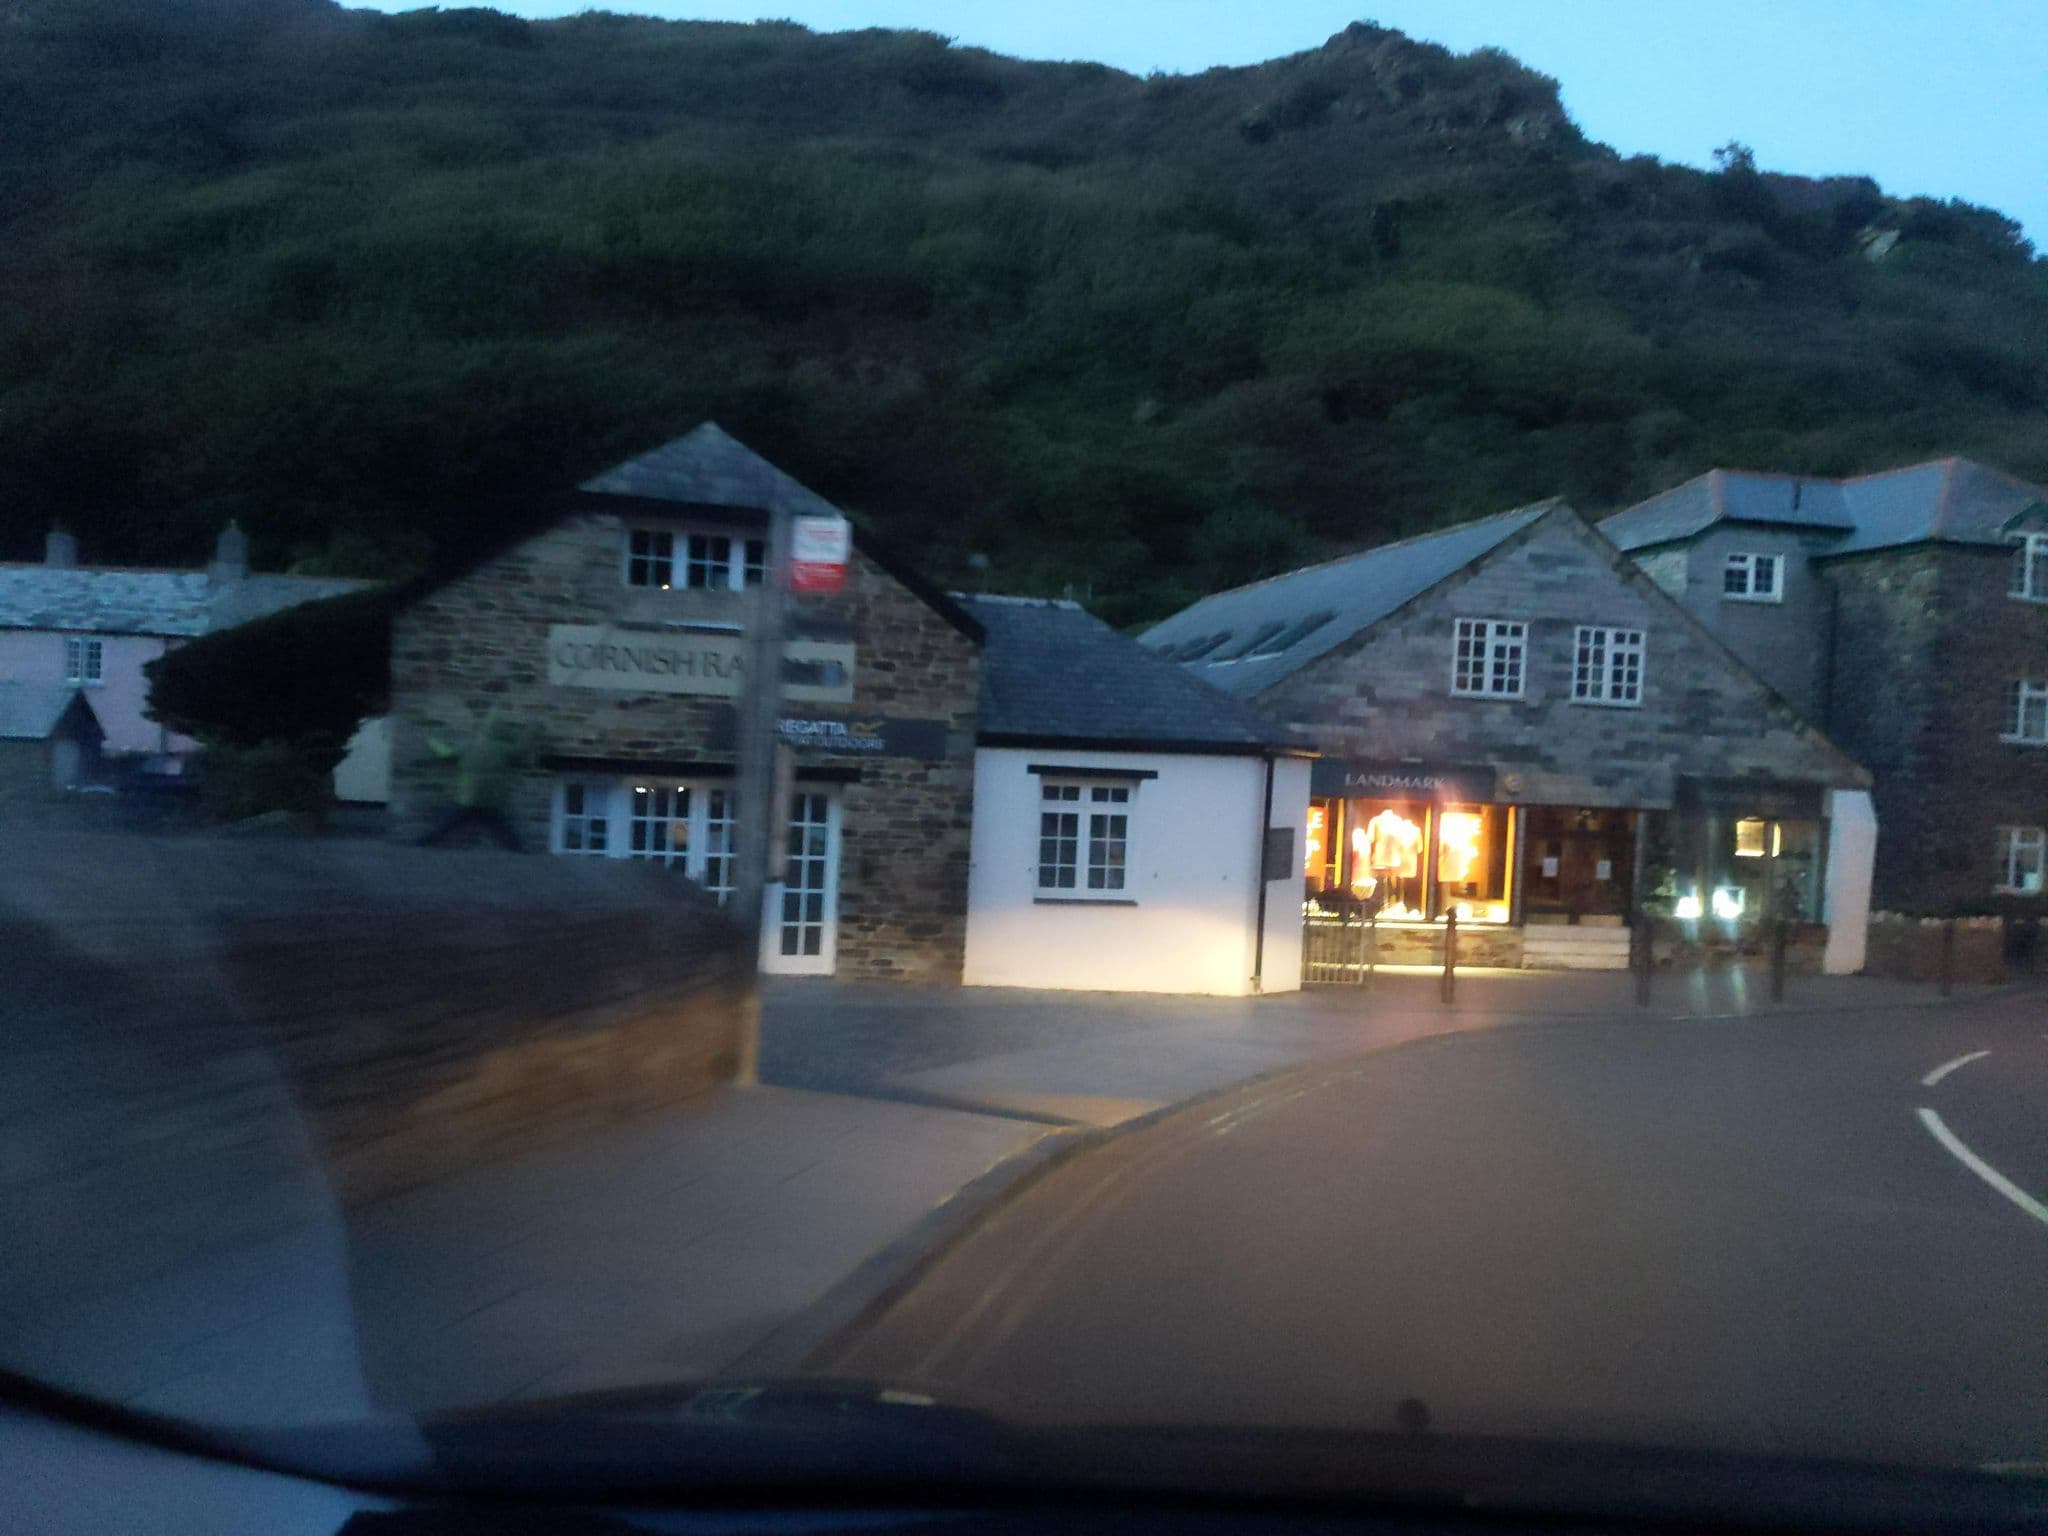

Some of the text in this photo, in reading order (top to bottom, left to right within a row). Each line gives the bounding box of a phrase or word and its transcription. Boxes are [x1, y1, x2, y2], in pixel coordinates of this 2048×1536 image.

[556, 643, 744, 678] CORNISH RA
[1346, 772, 1446, 788] LANDMARK
